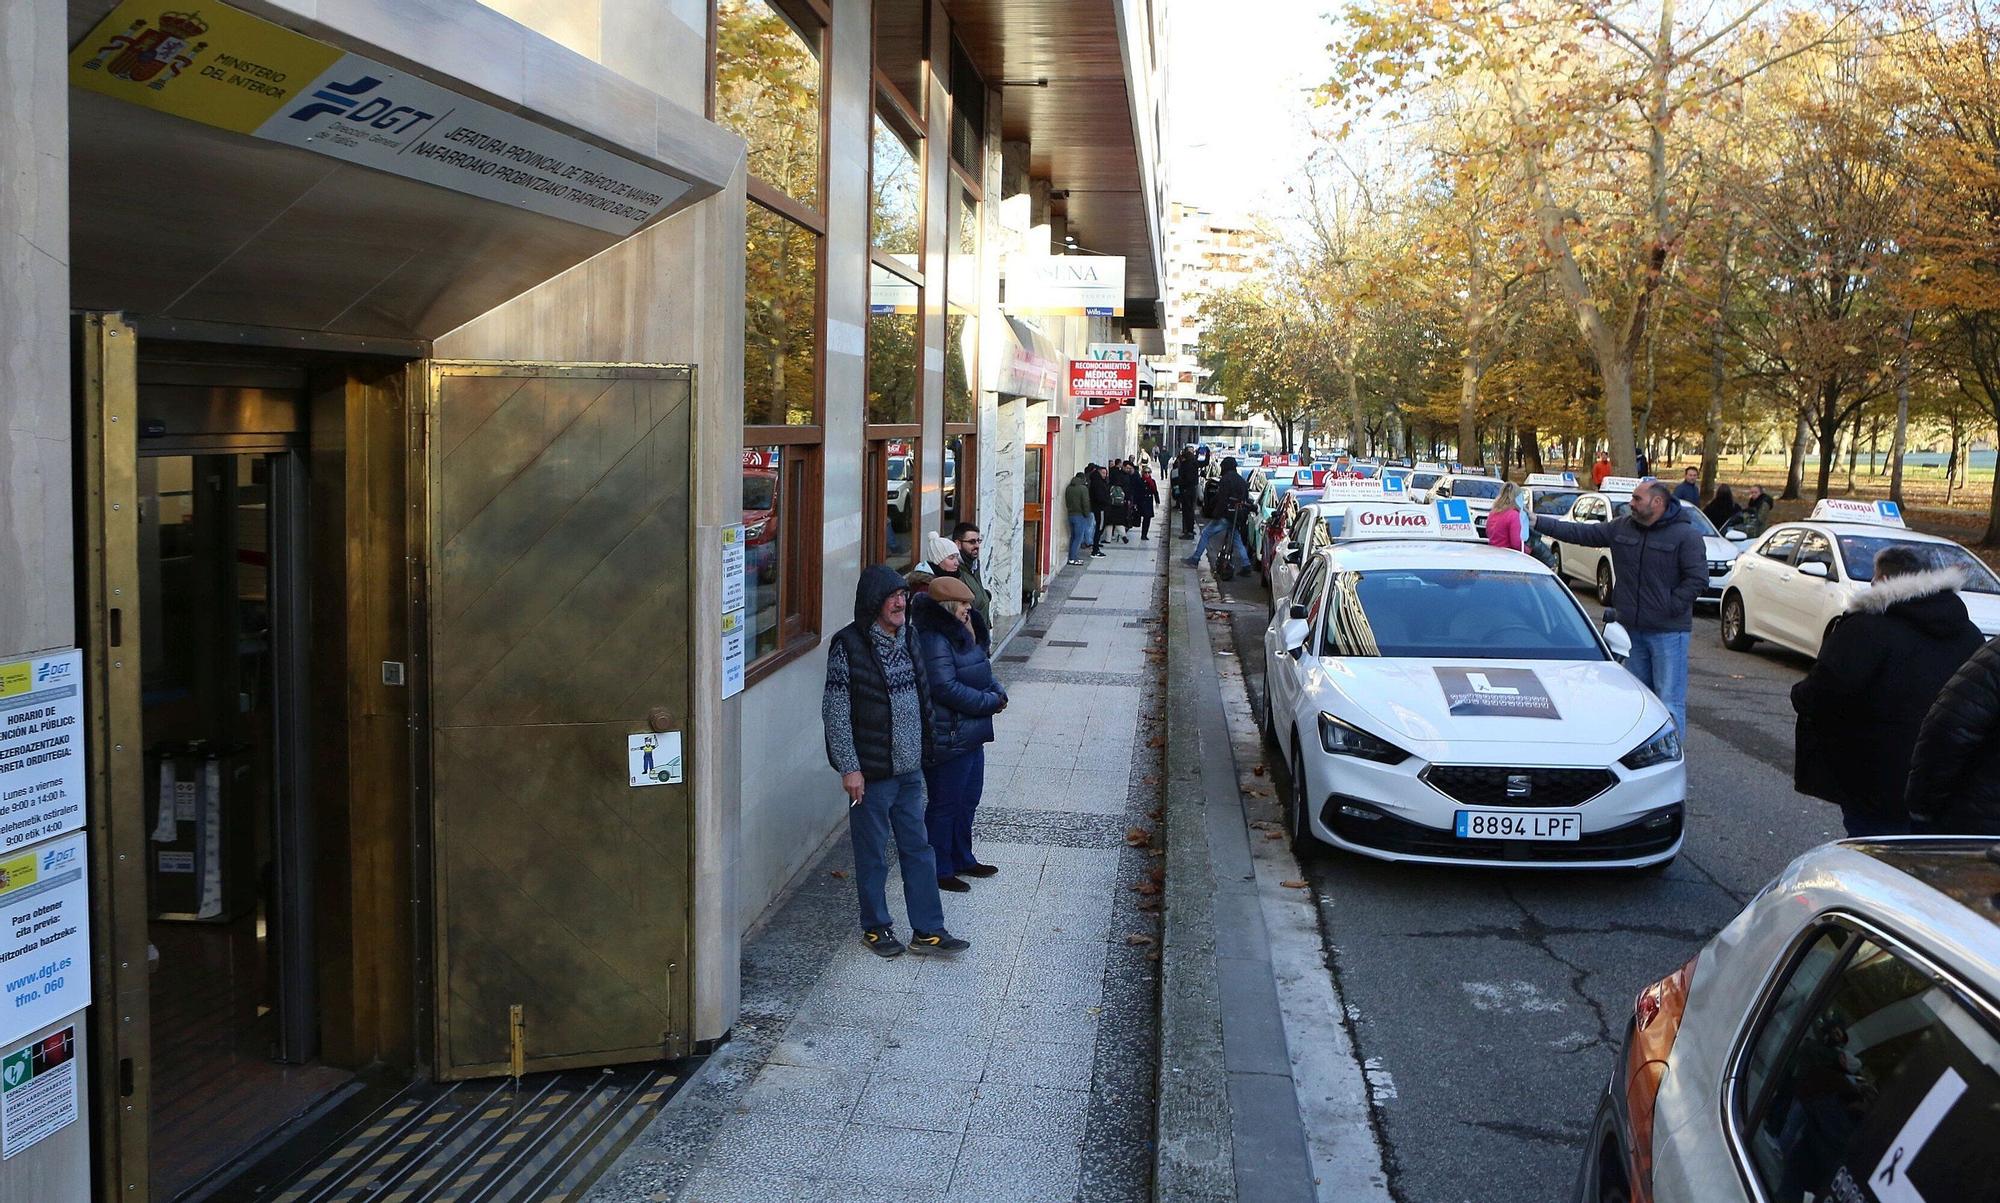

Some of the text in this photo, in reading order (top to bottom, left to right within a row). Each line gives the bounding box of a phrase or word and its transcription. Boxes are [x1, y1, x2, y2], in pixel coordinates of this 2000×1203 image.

[214, 53, 286, 82] MINISTERIO
[200, 65, 286, 98] DEL INTERIOR
[345, 97, 435, 134] DGT
[411, 141, 497, 175] NAFARROAKO
[491, 166, 568, 197] PROBINTZIAKO
[563, 188, 616, 211] TRAFIKOKO
[444, 126, 663, 207] JEFATURA PROVINCIAL DE TRÁFICO DE NAVARRA
[1075, 362, 1130, 370] RECONOCIMIENTOS
[1085, 369, 1118, 378] MÉDICOS
[1072, 378, 1133, 389] CONDUCTORES
[1827, 500, 1875, 514] Cirauqui
[1360, 511, 1427, 526] Orvina
[51, 662, 71, 675] DGT
[8, 706, 56, 725] HORARIO DE
[28, 724, 39, 734] AL
[41, 716, 75, 731] PÚBLICO:
[26, 748, 72, 766] ORDUTEGIA:
[3, 788, 27, 801] Lunes
[36, 778, 63, 791] viernes
[0, 806, 10, 815] de
[12, 800, 29, 812] 9:00
[38, 791, 58, 804] 14:00
[59, 789, 67, 798] h.
[43, 804, 78, 820] ostiralera
[6, 821, 63, 846] 9:00 etik 14:00
[1473, 816, 1526, 835] 8894
[1534, 818, 1574, 836] LPF
[56, 848, 76, 862] DGT
[12, 901, 63, 926] Para obtener
[16, 915, 61, 938] cita previa:
[0, 942, 38, 963] Hitzordua
[6, 957, 72, 992] www.dgt.es
[15, 977, 64, 1007] tfno. 060
[6, 1087, 28, 1099] ESPACIO
